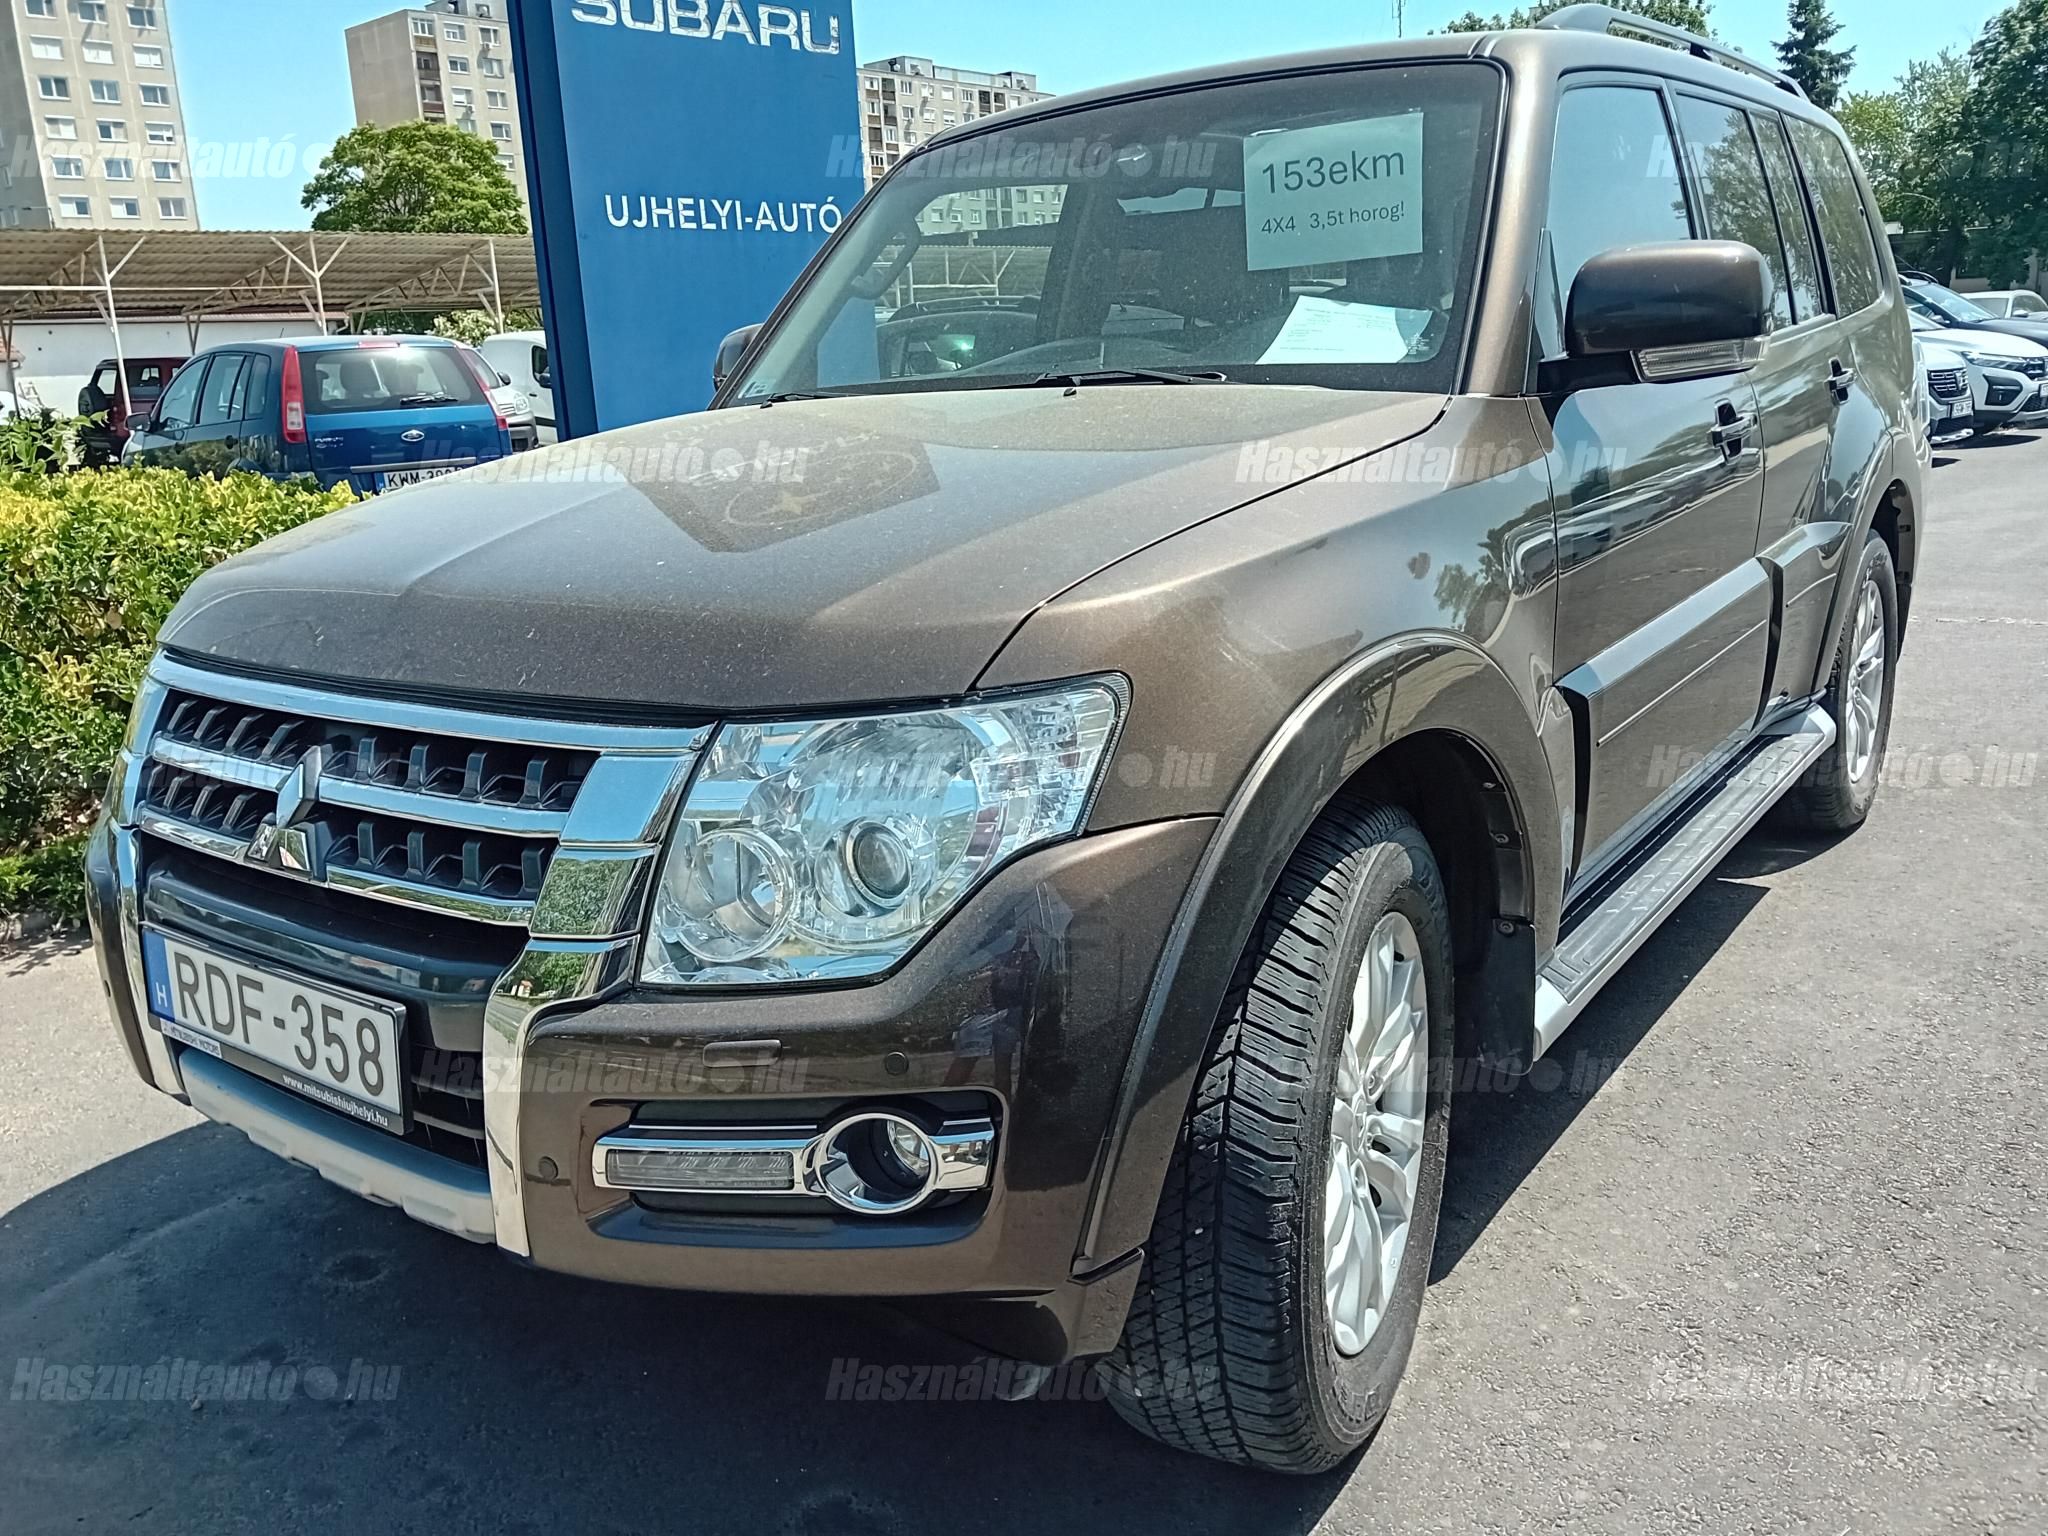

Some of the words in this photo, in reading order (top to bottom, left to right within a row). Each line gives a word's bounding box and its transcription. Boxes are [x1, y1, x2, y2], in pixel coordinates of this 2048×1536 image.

[571, 0, 839, 54] SUBARU
[1262, 150, 1404, 193] 153ekm
[604, 194, 843, 233] UJHELYI-AUTÓ
[1261, 215, 1296, 234] 4X4
[1309, 211, 1345, 230] 3,5t
[1350, 200, 1405, 222] horog!
[155, 982, 168, 1007] H
[174, 951, 384, 1097] RDF-358
[282, 1074, 389, 1127] www.mitsubishiujhelyi.hu
